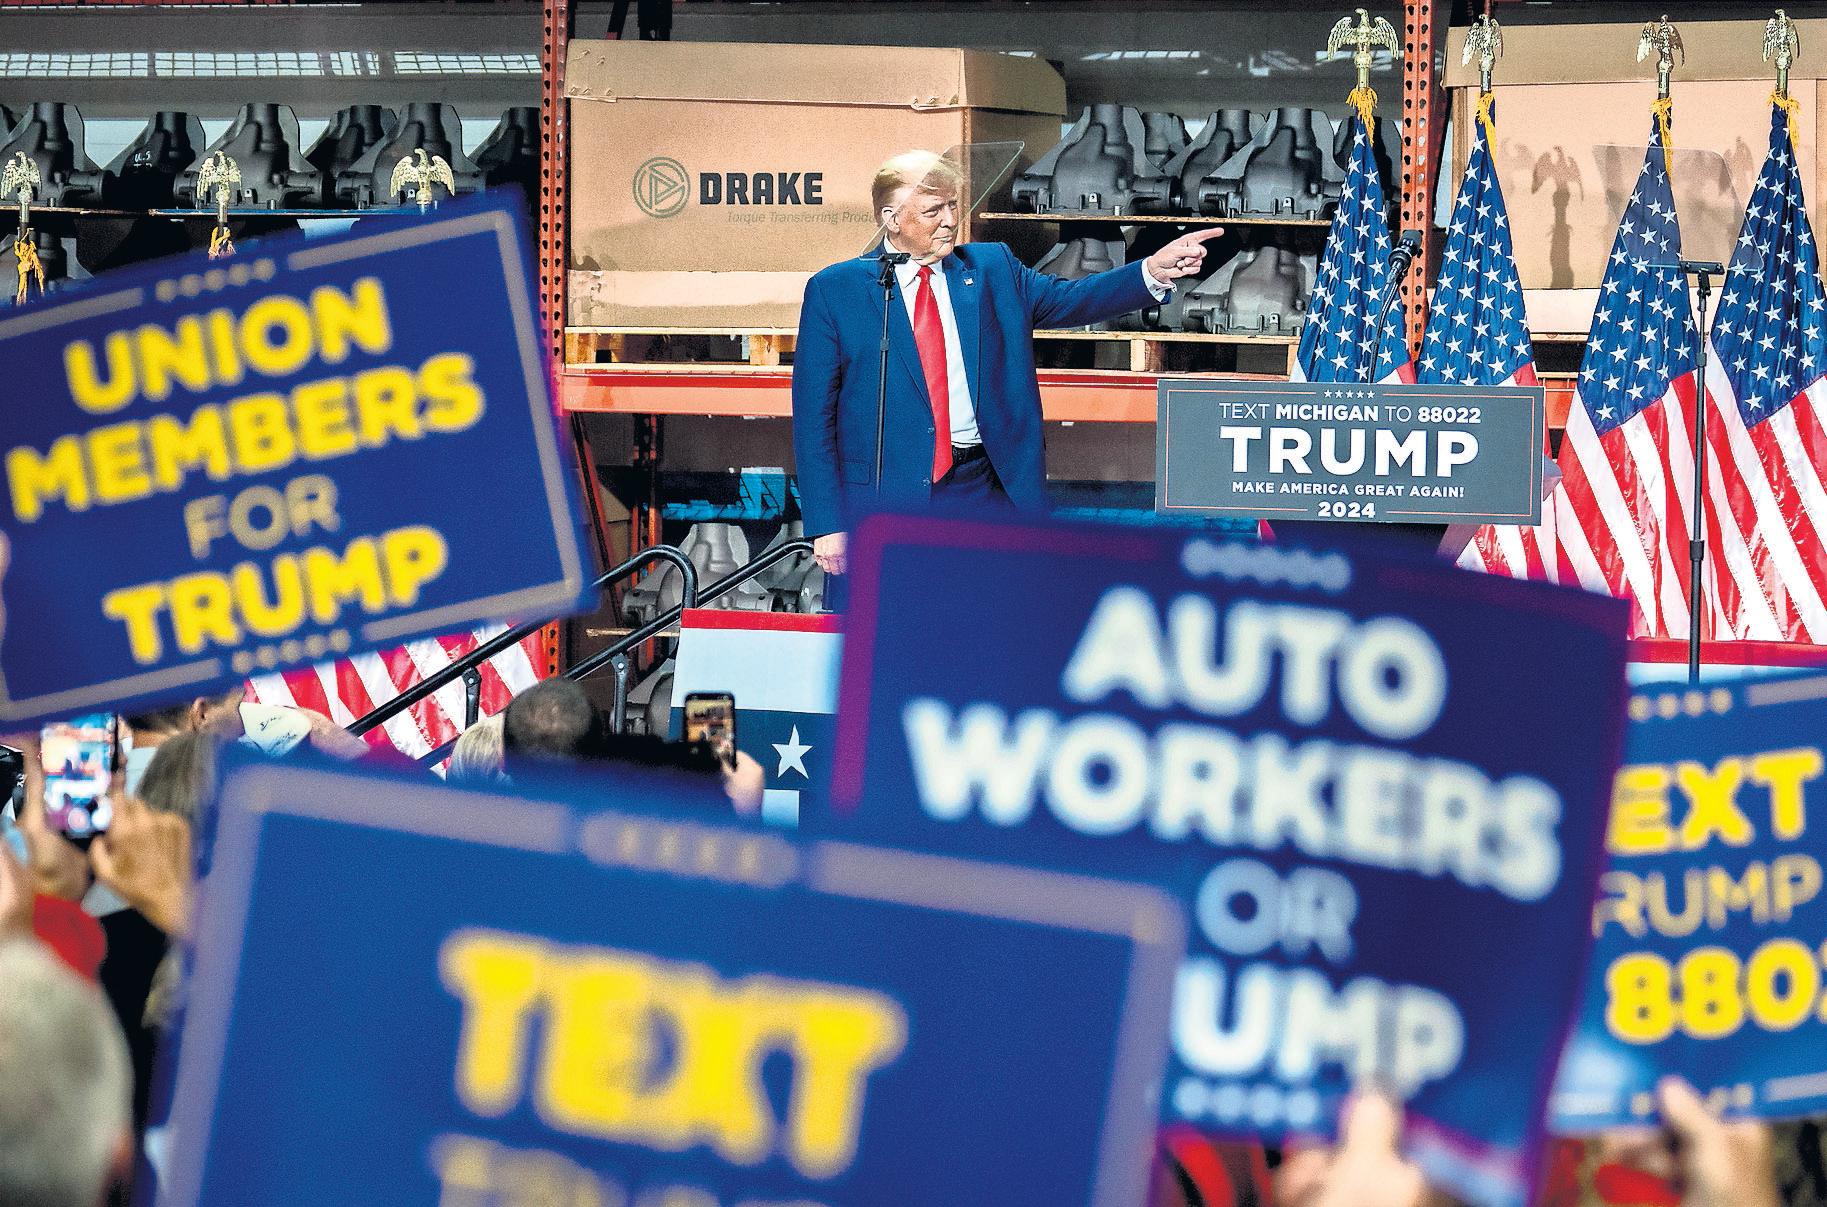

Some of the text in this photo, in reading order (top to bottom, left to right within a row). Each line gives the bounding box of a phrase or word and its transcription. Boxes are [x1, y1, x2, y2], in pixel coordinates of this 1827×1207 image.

[700, 172, 823, 205] DRAKE
[728, 211, 766, 225] Torque
[769, 211, 838, 225] Transferring
[64, 277, 391, 413] UNION
[6, 352, 485, 522] MEMBERS
[1219, 402, 1481, 424] TEXT MICHIGAN TO 88022
[1219, 425, 1479, 478] TRUMP
[184, 474, 340, 558] FOR
[1232, 481, 1465, 498] MAKE AMERICA GREAT AGAIN!
[1317, 501, 1376, 519] 2024
[104, 525, 448, 663] TRUMP
[1062, 586, 1448, 739] AUTO
[905, 697, 1562, 902] WORKERS
[1605, 938, 1827, 1044] 880
[438, 926, 908, 1179] TEXT
